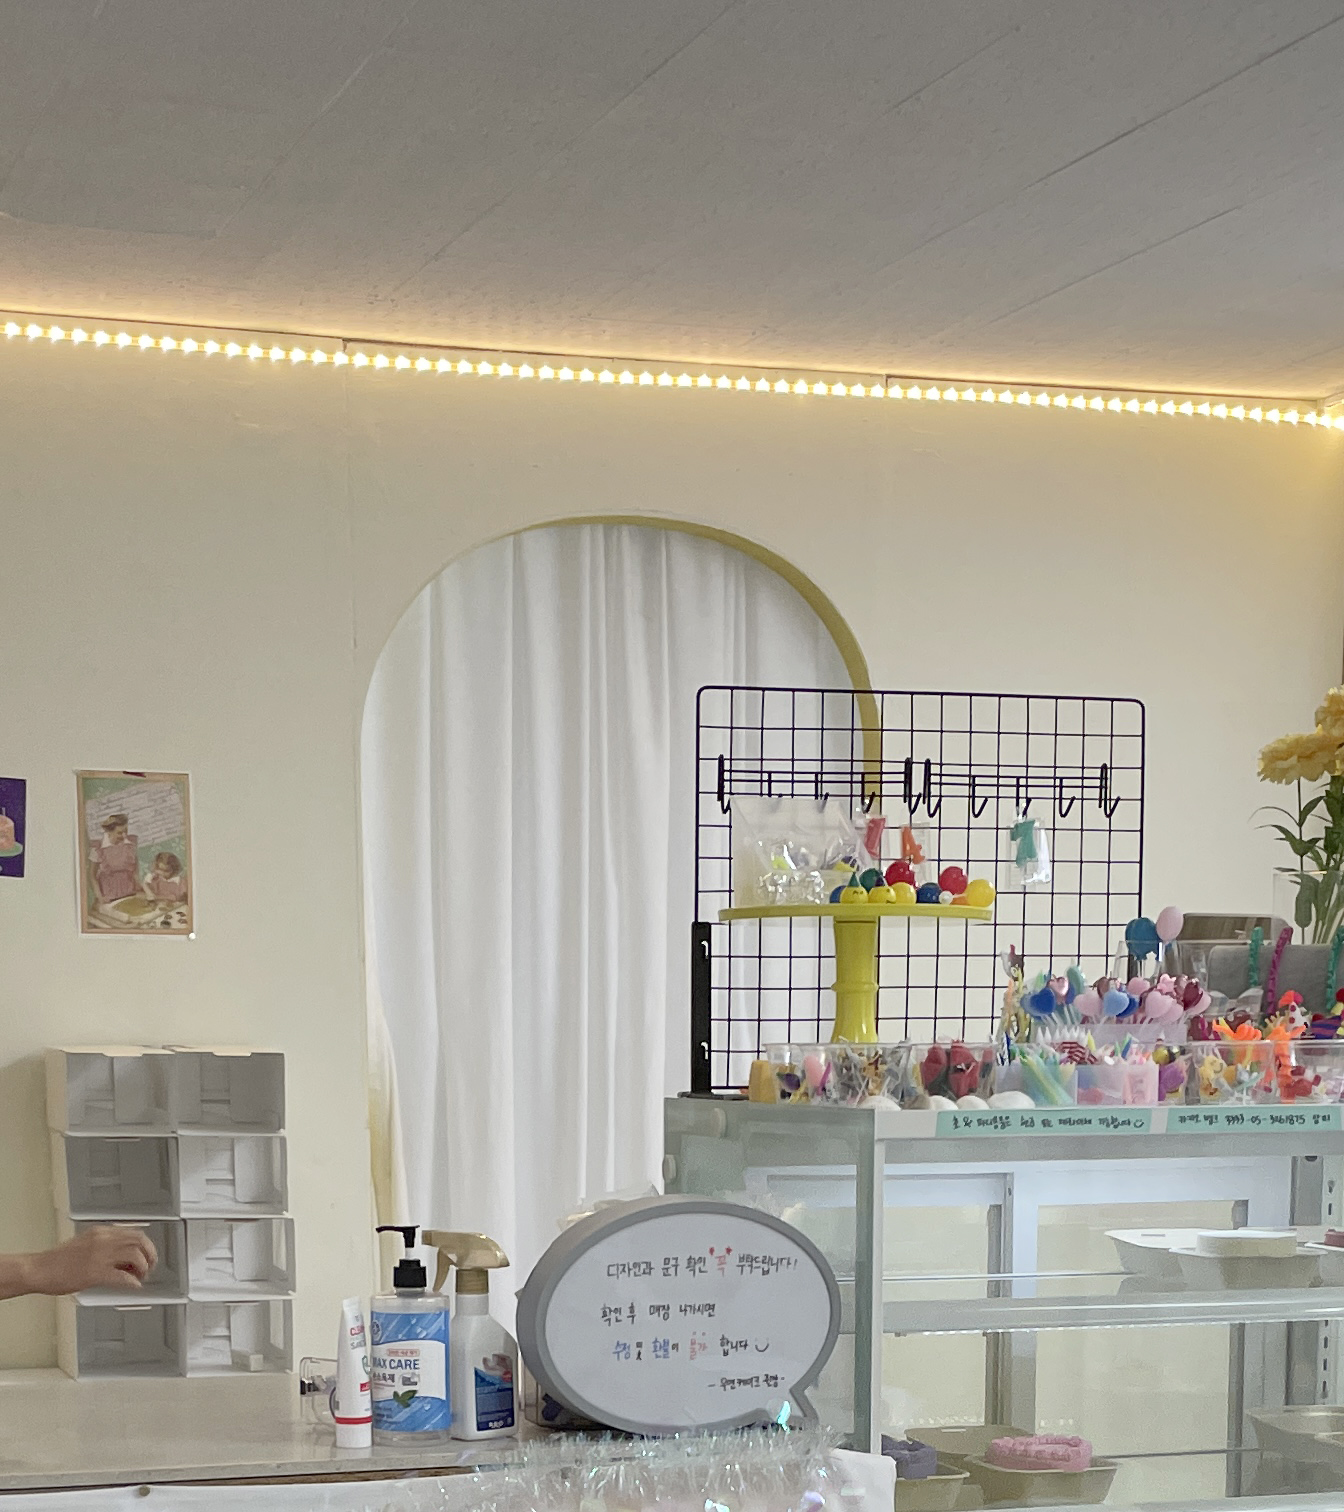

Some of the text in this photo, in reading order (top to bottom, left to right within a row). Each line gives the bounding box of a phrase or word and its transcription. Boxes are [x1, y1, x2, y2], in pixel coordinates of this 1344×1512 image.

[606, 1260, 656, 1280] 디자인과
[661, 1256, 680, 1277] 문구
[685, 1255, 708, 1279] 확인
[600, 1303, 623, 1326] 확인
[626, 1301, 637, 1325] 후
[649, 1303, 670, 1321] 매장
[612, 1340, 631, 1361] 수정
[719, 1334, 749, 1357] 합니다
[389, 1358, 421, 1370] CARE
